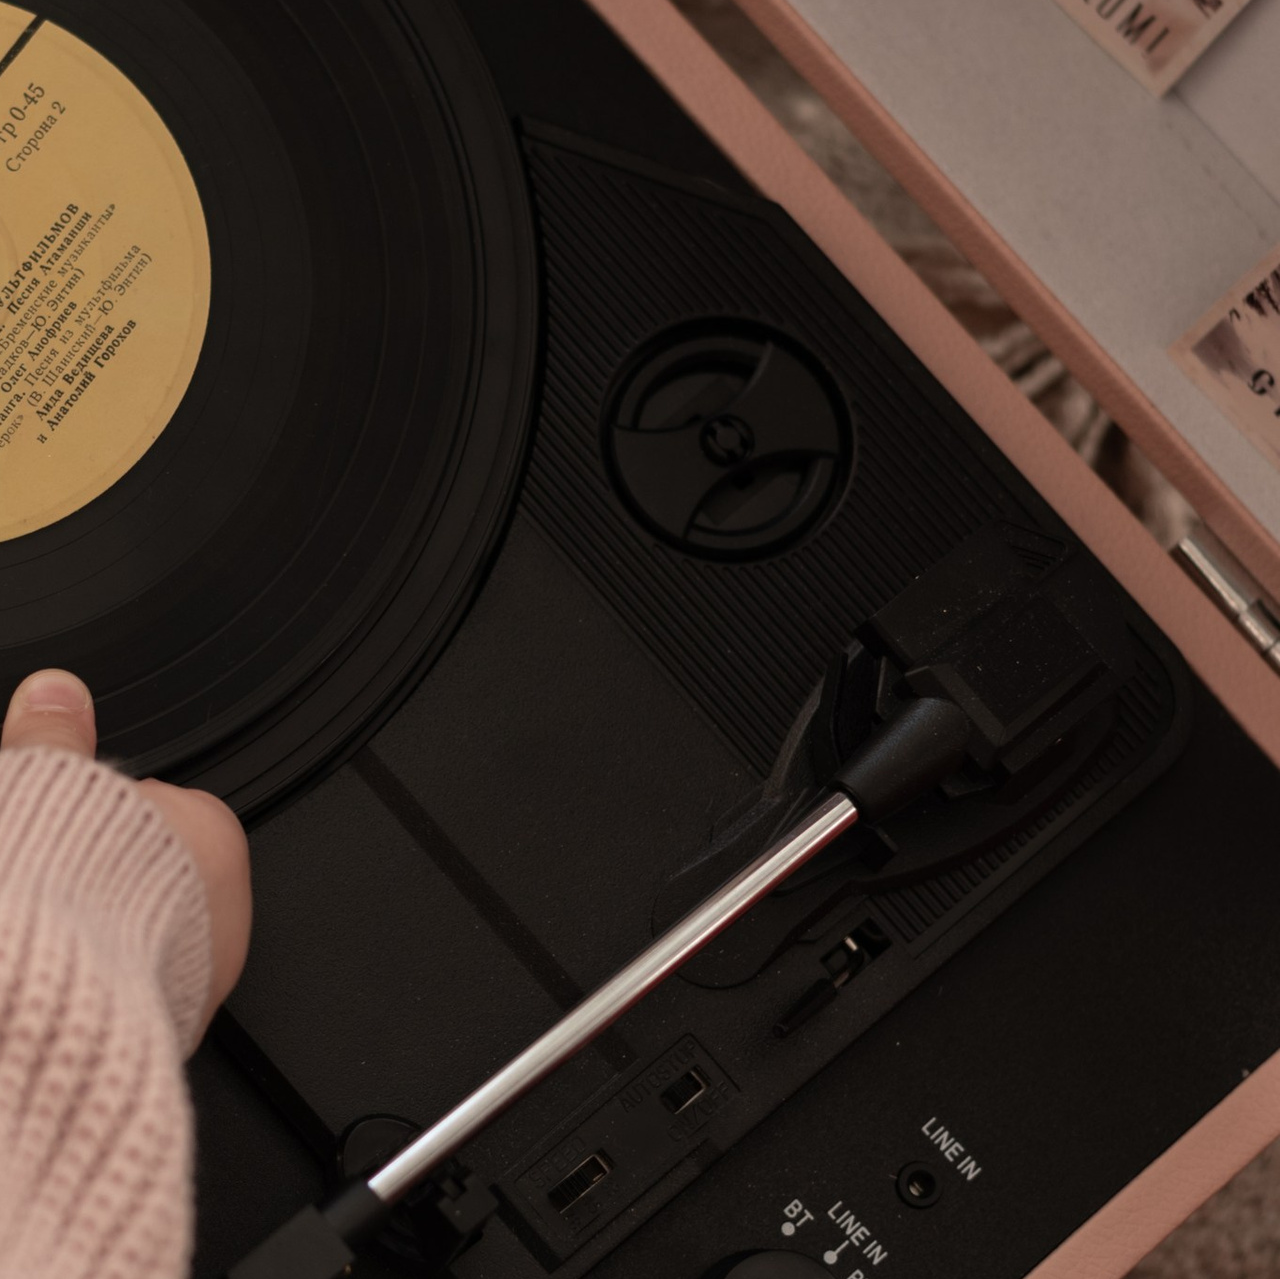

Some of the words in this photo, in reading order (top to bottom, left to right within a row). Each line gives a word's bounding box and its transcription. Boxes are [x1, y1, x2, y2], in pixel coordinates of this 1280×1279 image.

[9, 82, 44, 120] 0-45
[6, 115, 57, 171] Сторона
[51, 101, 65, 114] 2
[6, 277, 40, 314] Песня
[39, 212, 92, 275] Атаманши
[57, 203, 115, 277] музыканты»
[46, 268, 85, 311] Энтин)
[113, 253, 152, 296] Энтин)
[0, 363, 26, 392] Олег
[27, 301, 77, 361] Анофриев
[23, 348, 59, 386] Песня
[59, 329, 73, 344] из
[74, 245, 141, 325] мультфильма
[36, 389, 64, 421] Аида
[62, 325, 114, 385] Ведищева
[36, 433, 47, 443] и
[46, 371, 95, 431] Анатолий
[93, 320, 136, 368] Горохов
[528, 1137, 586, 1190] SPEED
[921, 1116, 964, 1163] LINE
[957, 1154, 982, 1182] IN
[783, 1199, 814, 1226] BT
[827, 1201, 870, 1246] LINE
[863, 1240, 887, 1264] IN
